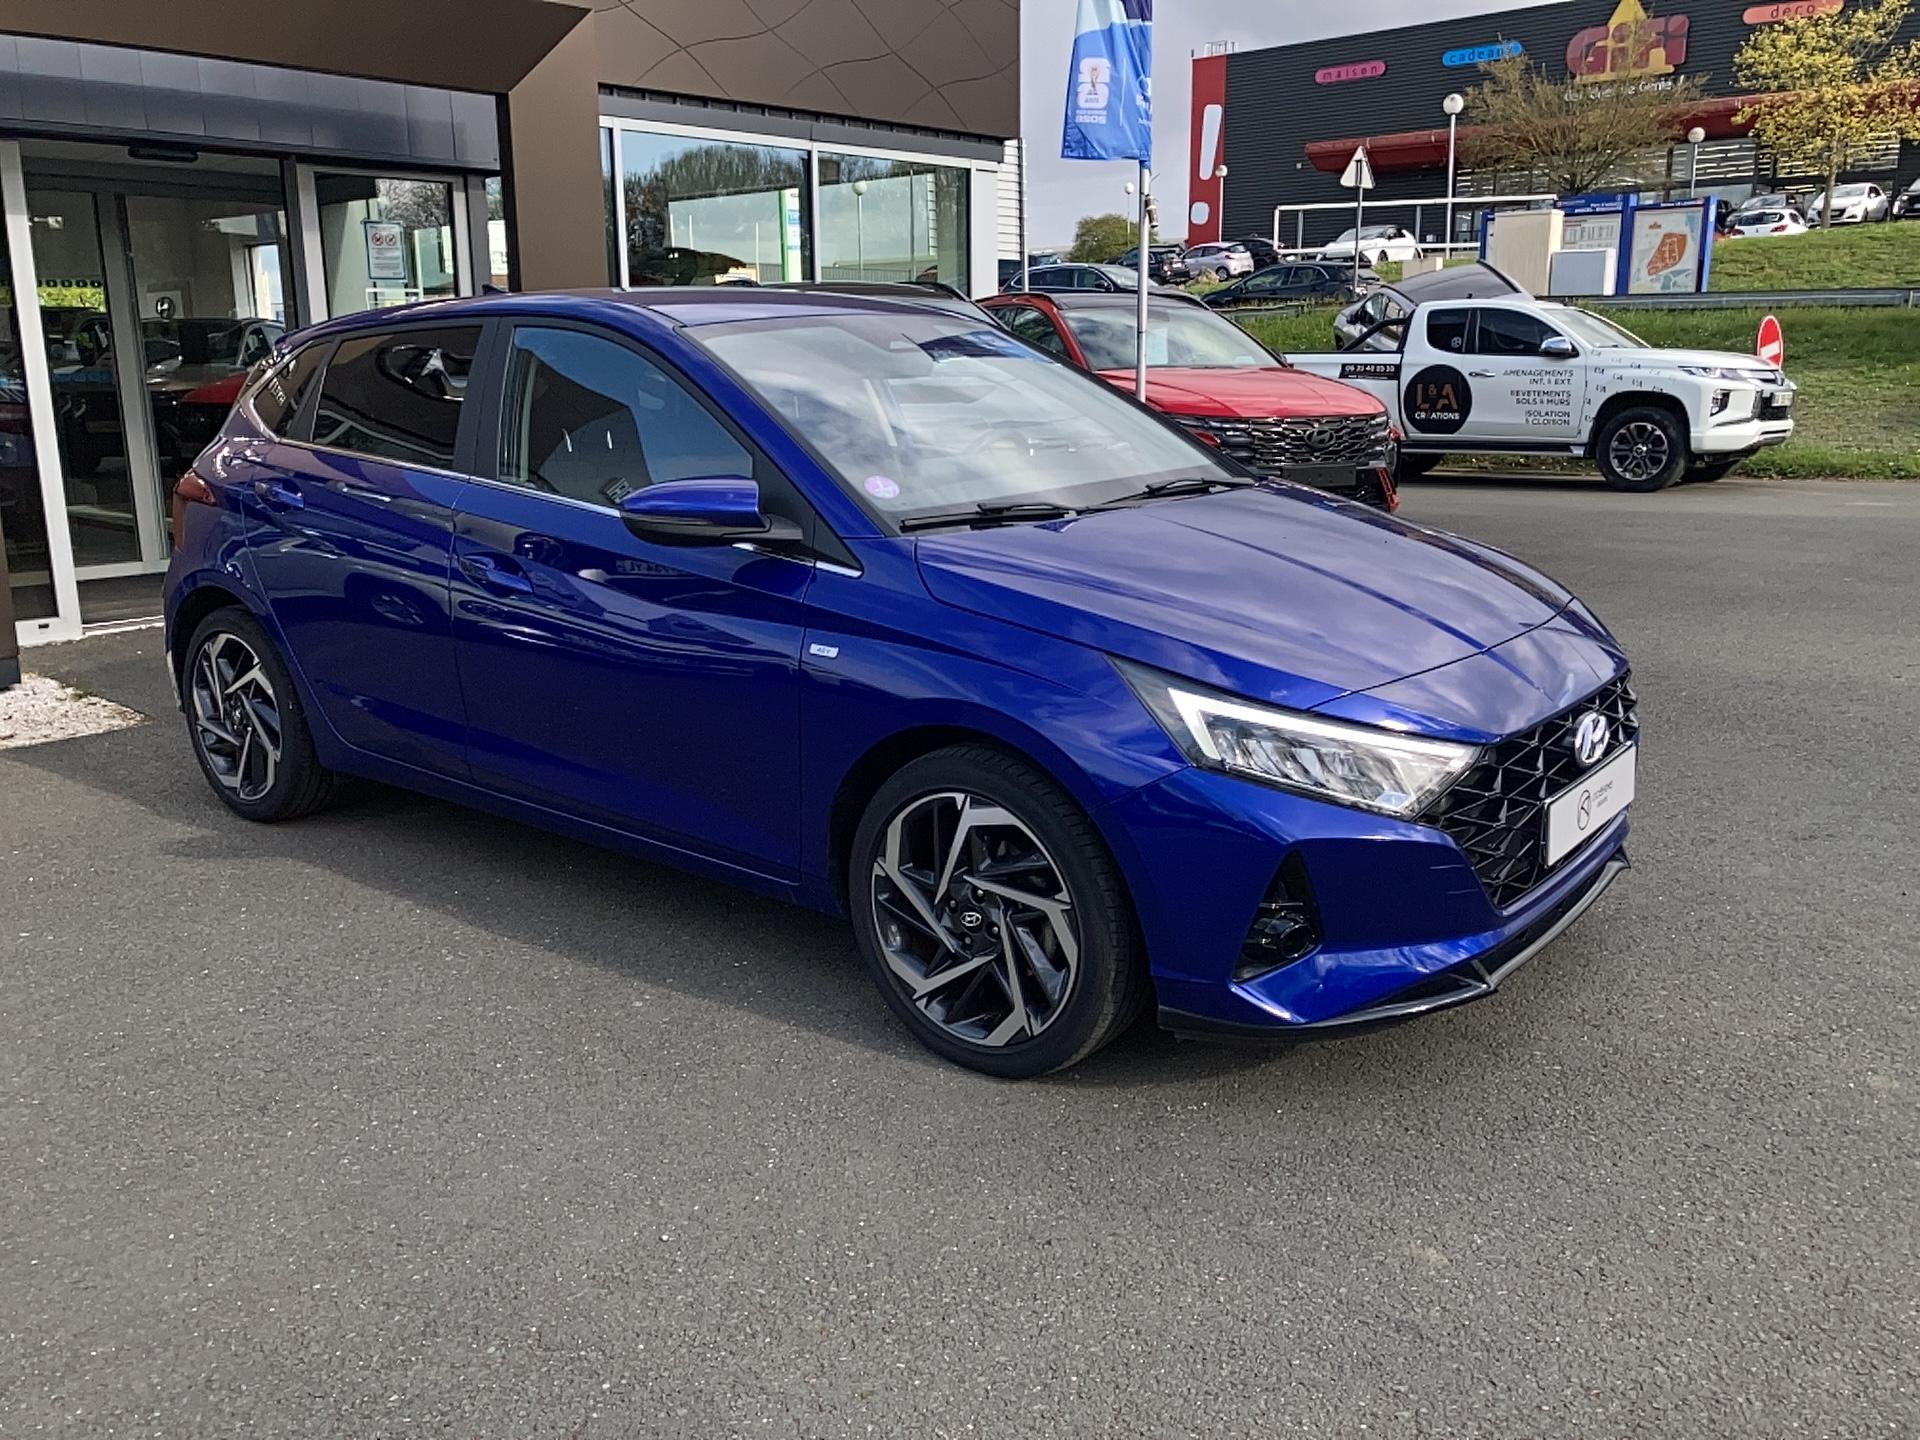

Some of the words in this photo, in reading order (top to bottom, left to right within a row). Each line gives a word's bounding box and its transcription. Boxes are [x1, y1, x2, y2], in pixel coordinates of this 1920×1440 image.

[1770, 5, 1815, 19] deco
[1323, 64, 1378, 81] maison
[1516, 398, 1538, 406] SOLS
[1531, 418, 1570, 426] CLOISON
